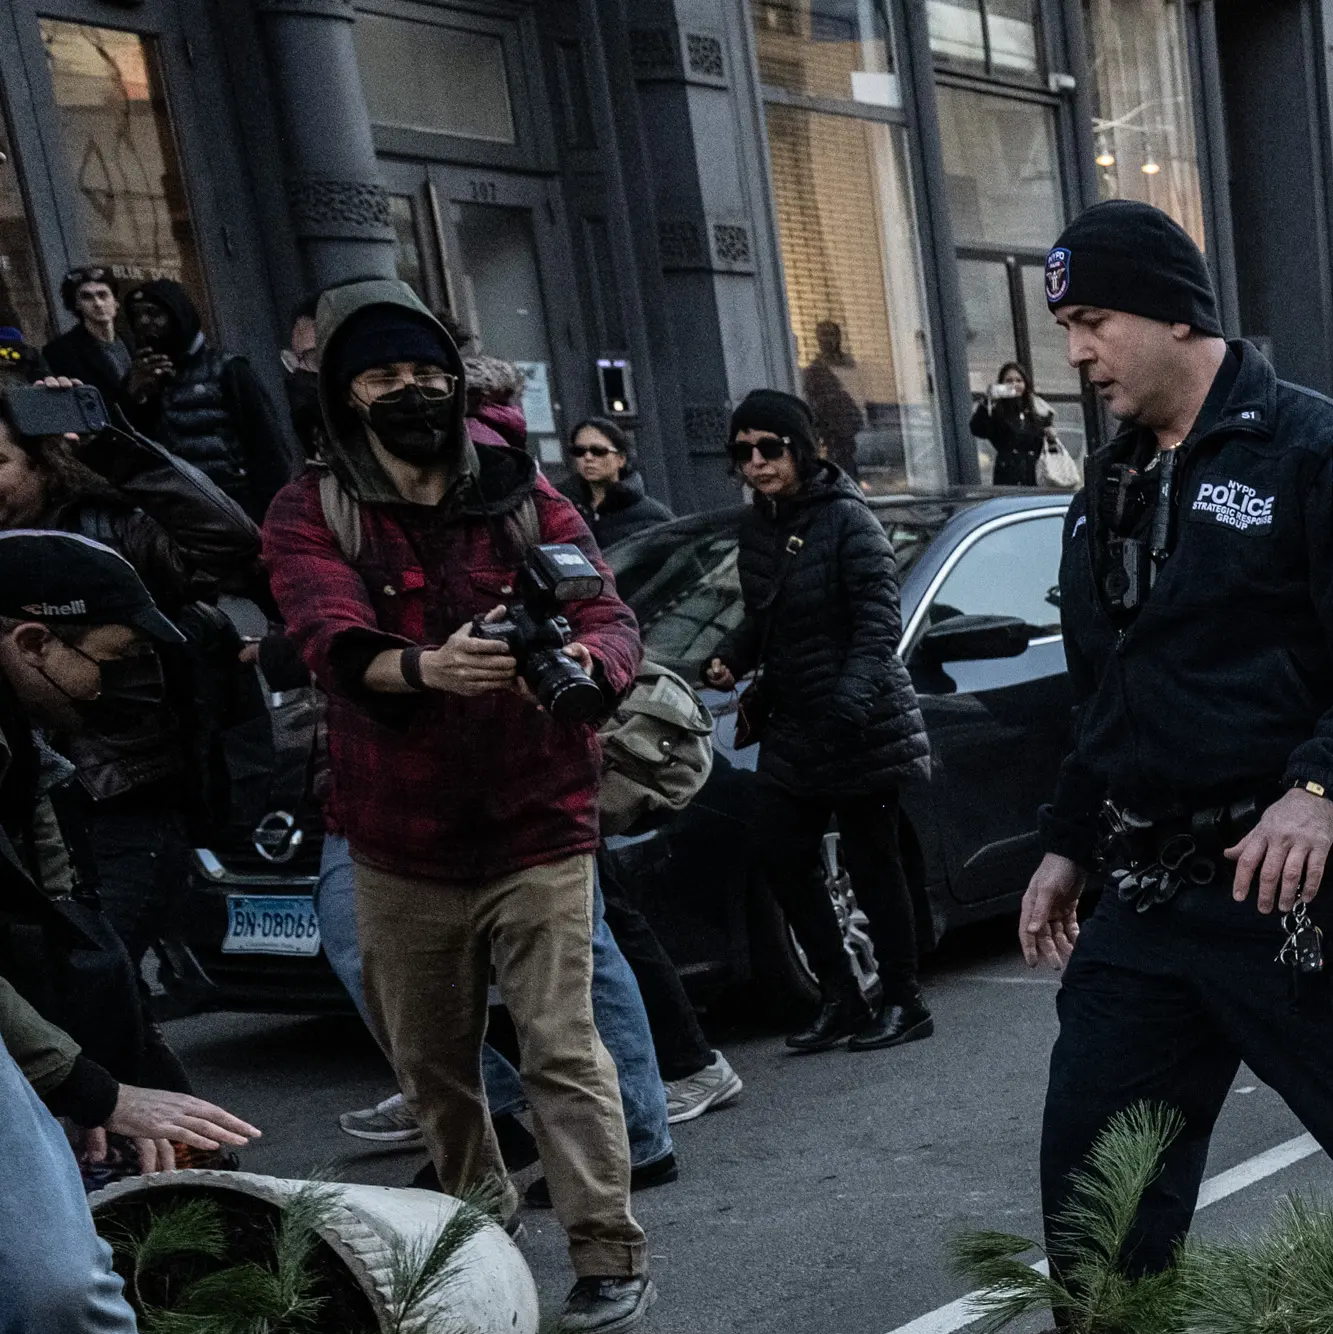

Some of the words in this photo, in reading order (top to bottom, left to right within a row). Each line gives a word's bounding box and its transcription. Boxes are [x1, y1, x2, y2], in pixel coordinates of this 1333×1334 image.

[1241, 411, 1255, 419] S1
[1228, 480, 1256, 497] NYPD
[1197, 483, 1275, 517] POLICE
[1192, 501, 1236, 517] STRATEGIC
[1235, 511, 1273, 526] RESPONSE
[1216, 513, 1249, 530] GROUP
